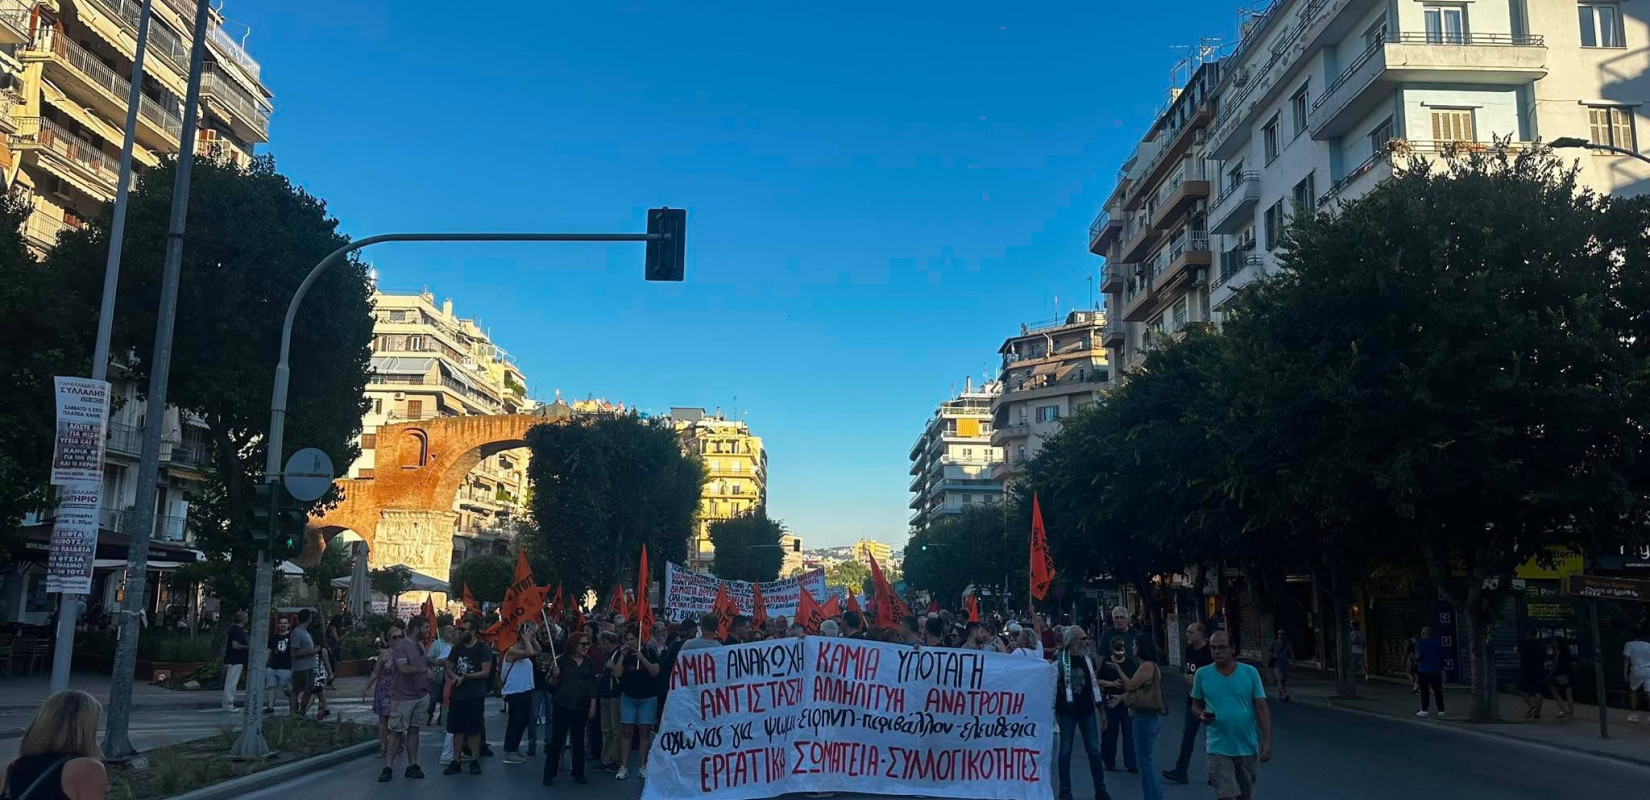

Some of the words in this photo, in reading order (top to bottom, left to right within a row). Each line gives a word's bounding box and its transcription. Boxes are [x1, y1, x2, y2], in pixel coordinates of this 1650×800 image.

[670, 652, 717, 690] ΑΜΙΑ
[727, 641, 804, 679] ΑΝΑΚΩΧΗ
[816, 641, 880, 681] ΚΑΜΙΑ
[898, 650, 985, 690] ΥΠΟΤΑΓΗ
[700, 677, 804, 721] ΑΝΤΙΣΤΑΣΗ
[924, 688, 1026, 716] ΑΝΑΤΡΟΠΗ
[660, 722, 723, 755] αγώνας
[730, 721, 753, 749] για
[700, 747, 787, 793] ΕΡΓΑΤΙΚΑ
